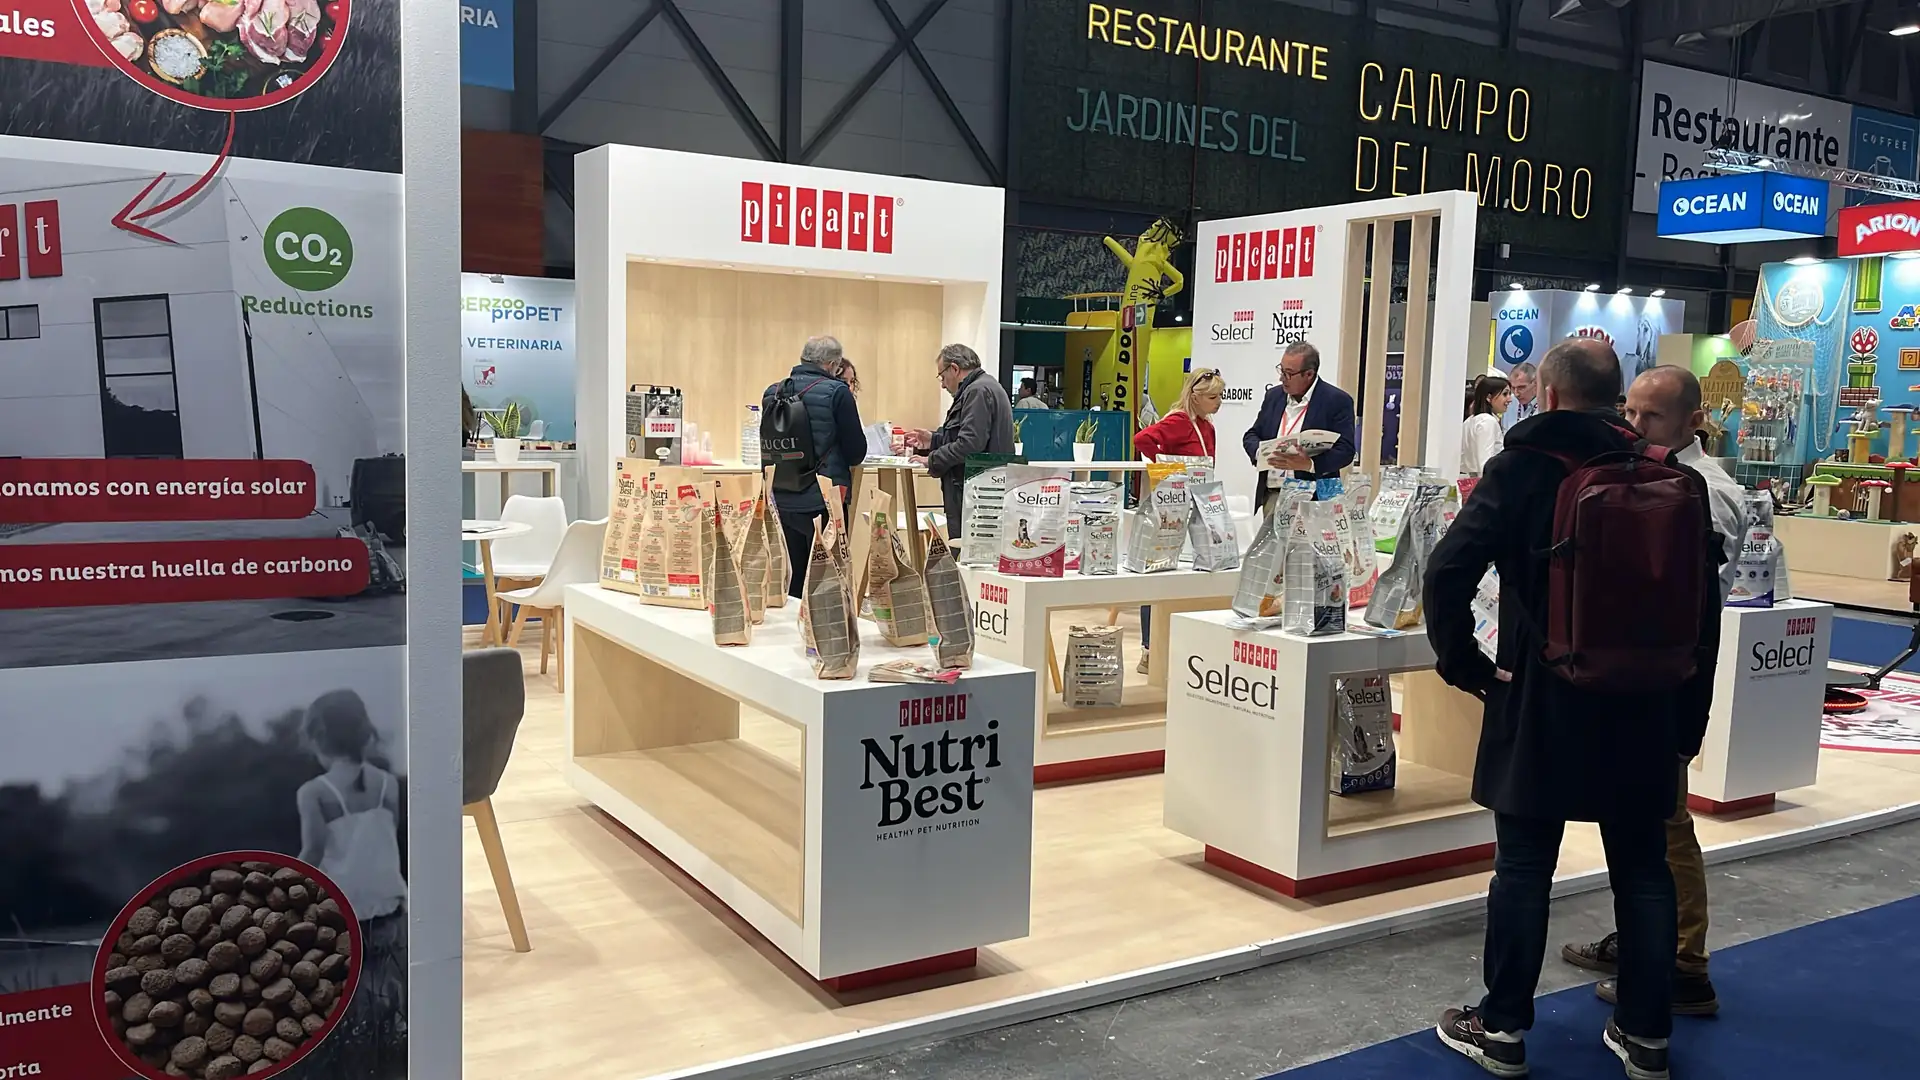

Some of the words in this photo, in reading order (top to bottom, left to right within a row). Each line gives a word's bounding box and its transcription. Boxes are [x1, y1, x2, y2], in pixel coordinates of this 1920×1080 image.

[1087, 3, 1329, 81] RESTAURANTE
[1359, 62, 1530, 142] CAMPO
[1066, 87, 1240, 152] JARDINES
[1249, 113, 1306, 163] DEL
[1651, 92, 1840, 167] Restaurante
[1862, 132, 1908, 151] COFFEE
[1465, 152, 1592, 219] MORO
[743, 190, 889, 239] picart
[1672, 191, 1747, 216] OCEAN
[1773, 191, 1820, 216] OCEAN
[1855, 213, 1920, 245] ARION
[1216, 236, 1313, 280] picart
[243, 294, 374, 320] Reductions
[491, 306, 563, 323] proPET
[1272, 310, 1313, 331] Nutri
[1499, 308, 1539, 321] OCEAN
[467, 336, 563, 351] VETERINARIA
[1211, 322, 1255, 341] Select
[1275, 328, 1308, 345] Best
[1113, 371, 1129, 411] HOT
[106, 479, 150, 496] con
[155, 476, 246, 500] energía
[251, 479, 307, 496] solar
[991, 475, 1006, 484] Sel
[1017, 491, 1063, 507] Select
[1156, 490, 1187, 505] Select
[50, 561, 146, 583] nuestra
[152, 558, 226, 579] huella
[231, 557, 258, 576] de
[263, 555, 353, 575] carbono
[971, 601, 1009, 636] lect
[1233, 642, 1278, 669] picart
[1750, 637, 1815, 672] Select
[1187, 654, 1279, 711] Select
[1347, 687, 1386, 705] Select
[900, 698, 965, 725] picart
[859, 719, 1002, 790] Nutri
[877, 771, 985, 828] Best
[876, 829, 915, 842] HEALTHY
[917, 825, 933, 835] PET
[936, 818, 980, 832] NUTRITION
